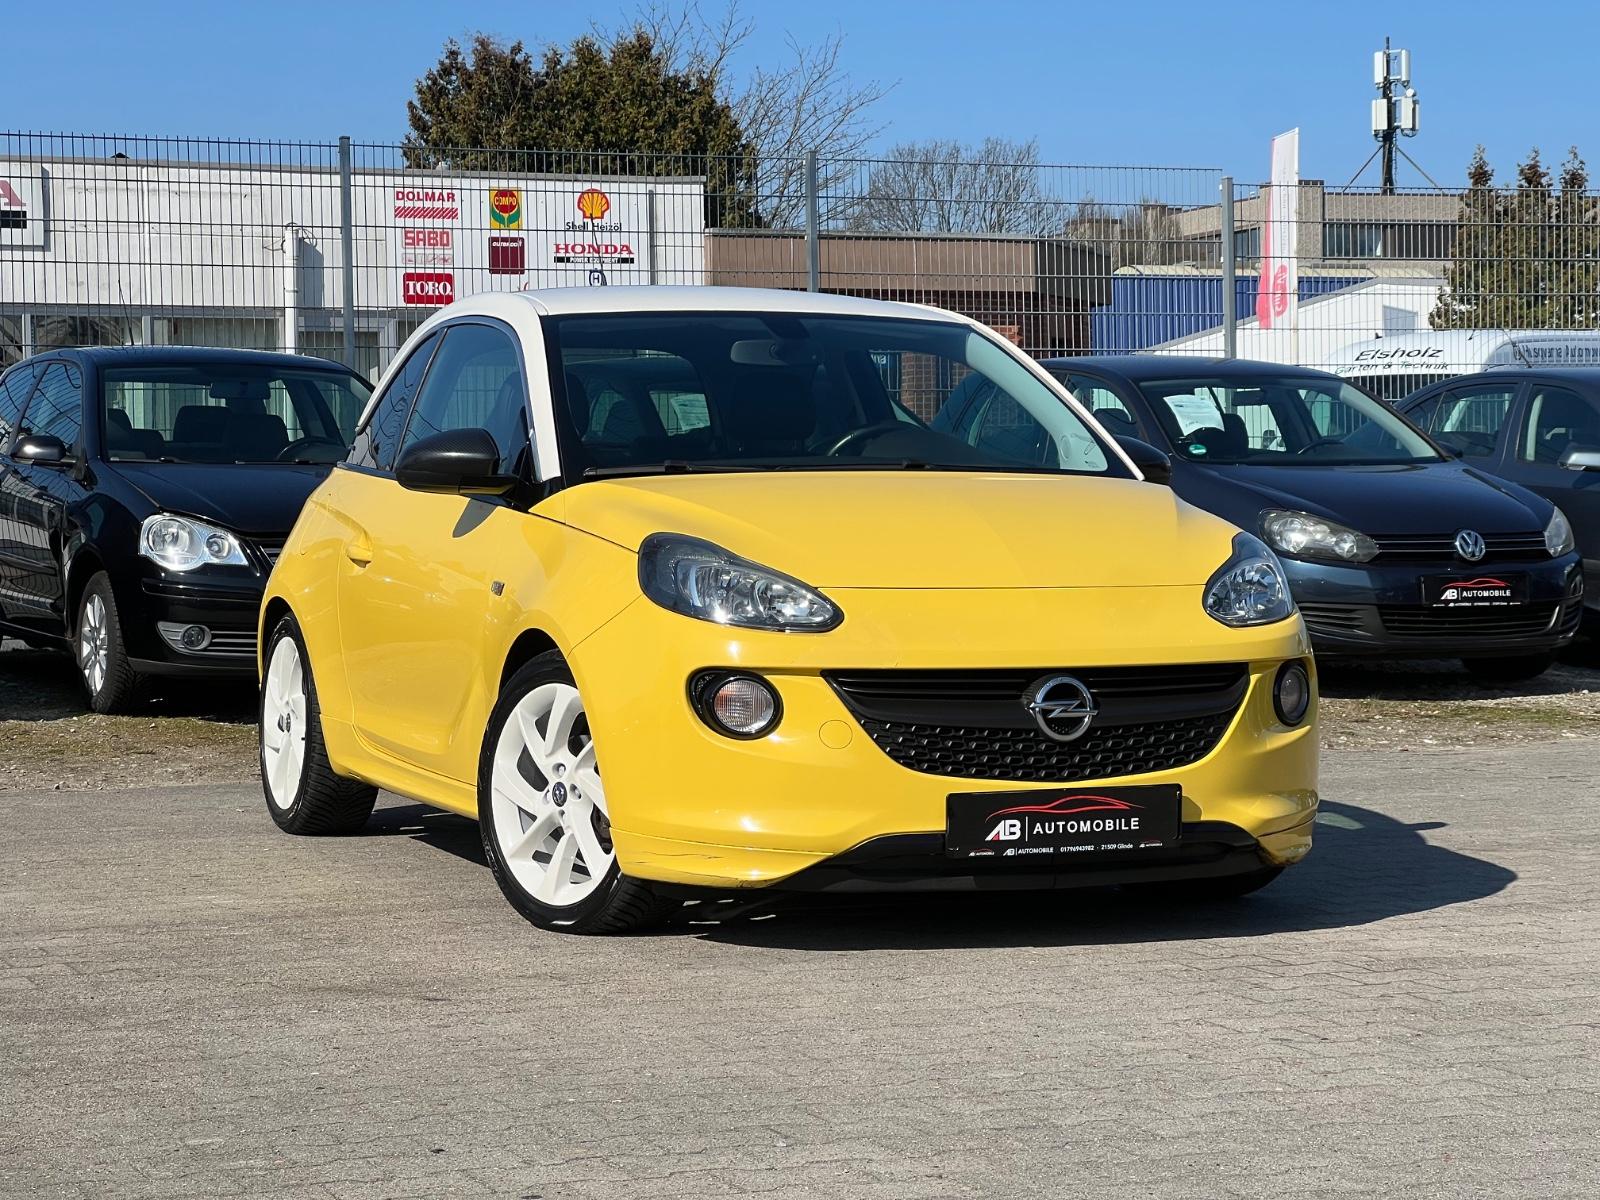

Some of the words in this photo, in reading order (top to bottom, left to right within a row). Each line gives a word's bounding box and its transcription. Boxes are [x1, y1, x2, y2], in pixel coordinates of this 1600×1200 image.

[396, 190, 456, 202] DOLMAR
[494, 196, 517, 206] COMPO
[566, 221, 589, 231] Shell
[592, 222, 622, 232] Heizöl
[404, 230, 450, 247] SABO
[553, 243, 635, 255] HONDA
[406, 281, 452, 296] TORO
[1355, 347, 1444, 361] Elsholz
[1462, 589, 1512, 597] AUTOMOBILE
[1032, 817, 1140, 835] AUTOMOBILE
[1018, 846, 1054, 855] AUTOMOBILE
